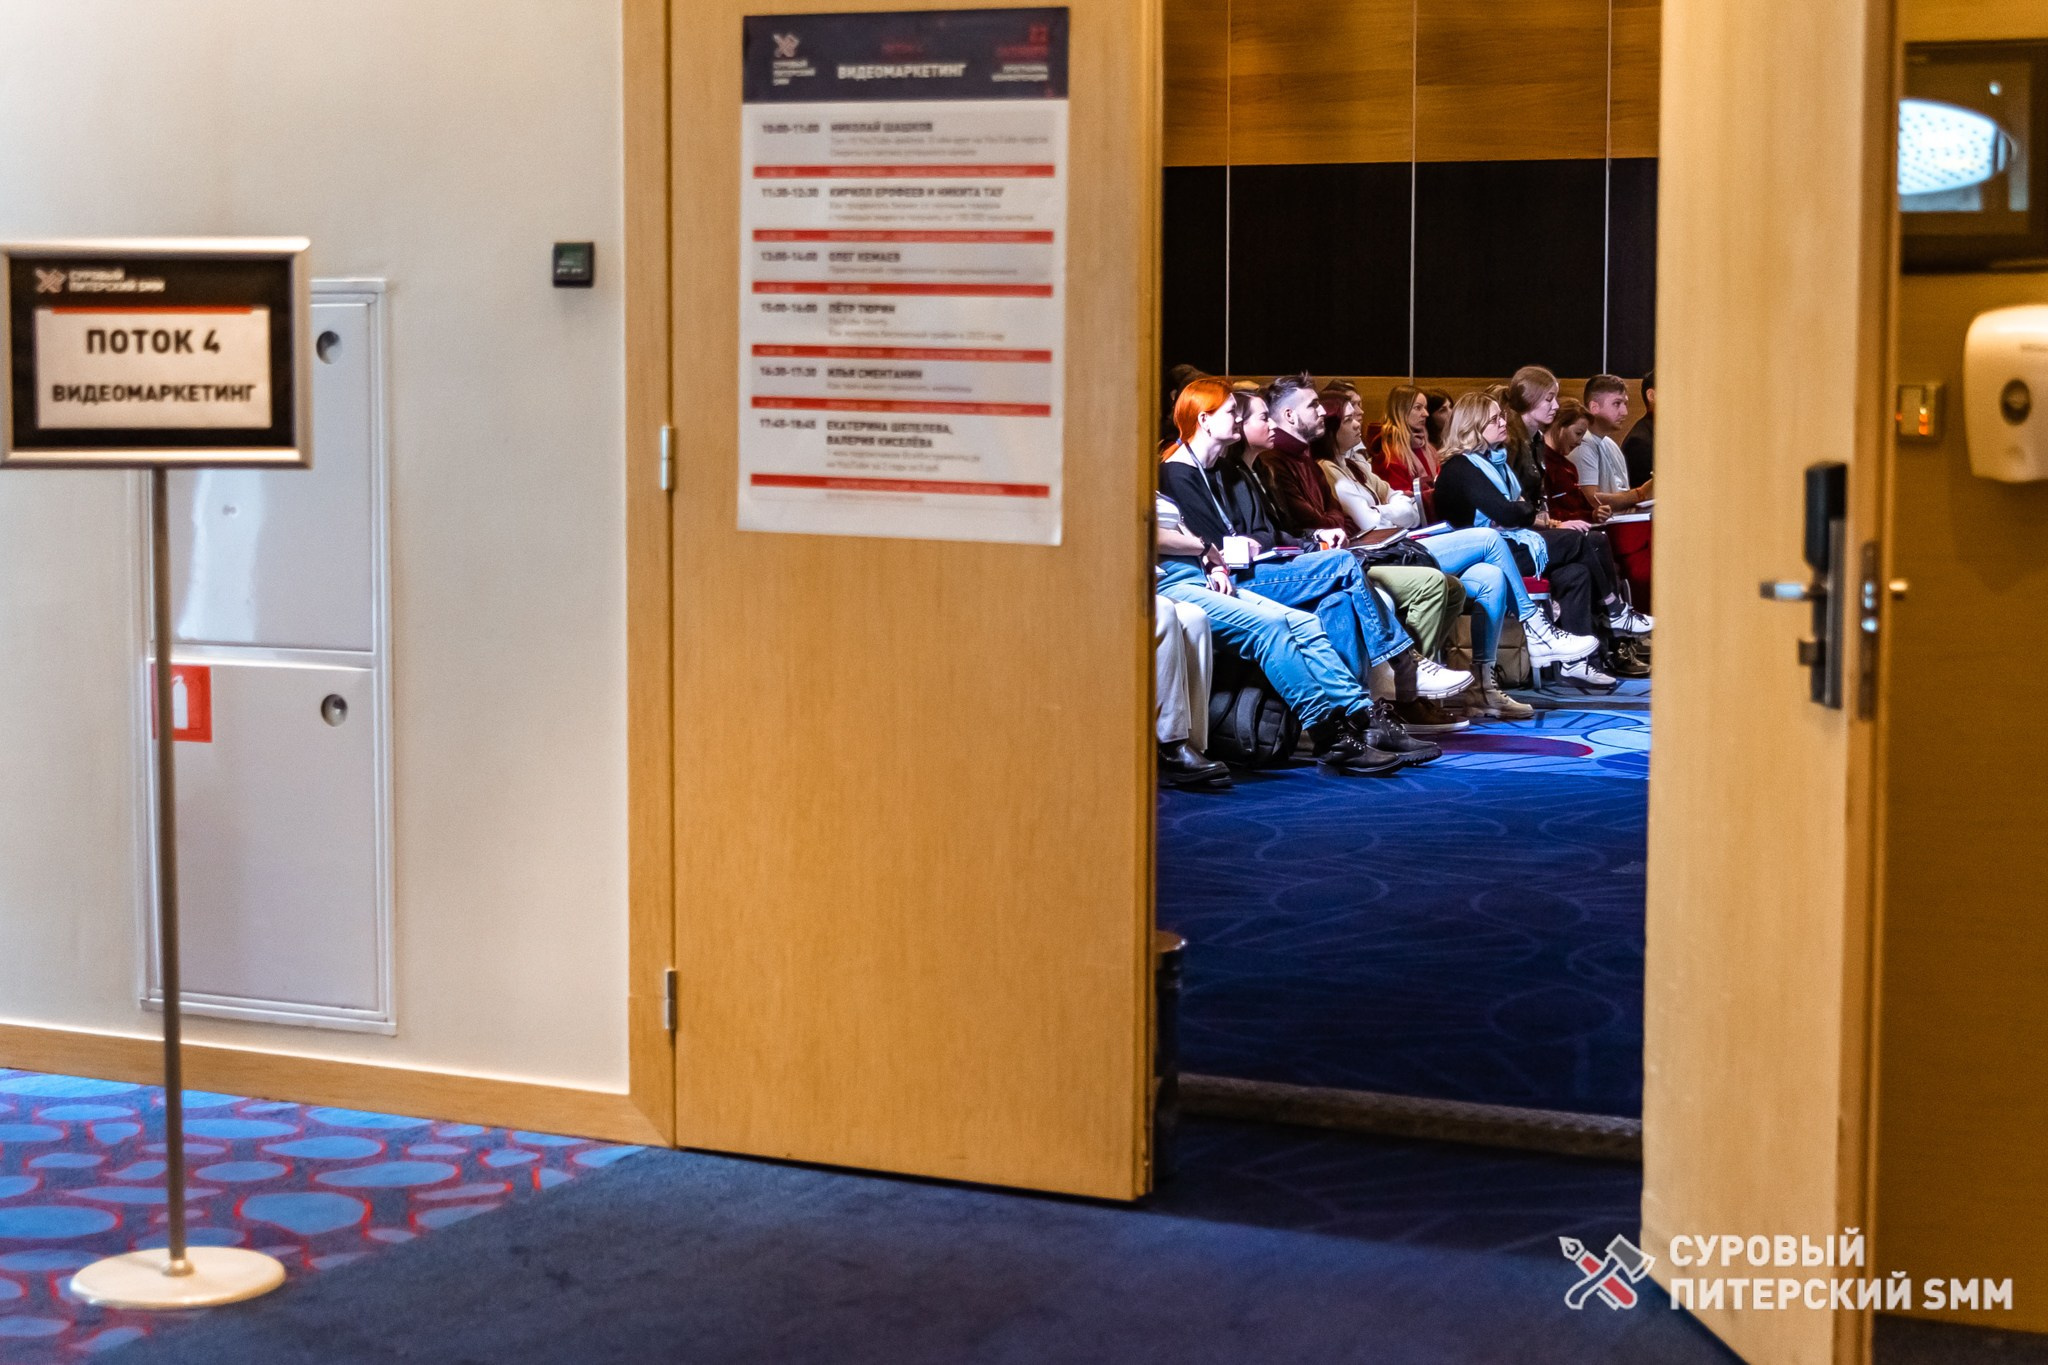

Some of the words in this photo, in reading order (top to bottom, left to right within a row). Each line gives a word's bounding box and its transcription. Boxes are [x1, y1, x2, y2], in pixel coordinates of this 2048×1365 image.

[837, 63, 968, 81] ВИДЕОМАРКЕТИНГ
[86, 329, 195, 354] ПОТОК
[203, 329, 221, 354] 4
[52, 384, 256, 405] ВИДЕОМАРКЕТИНГ
